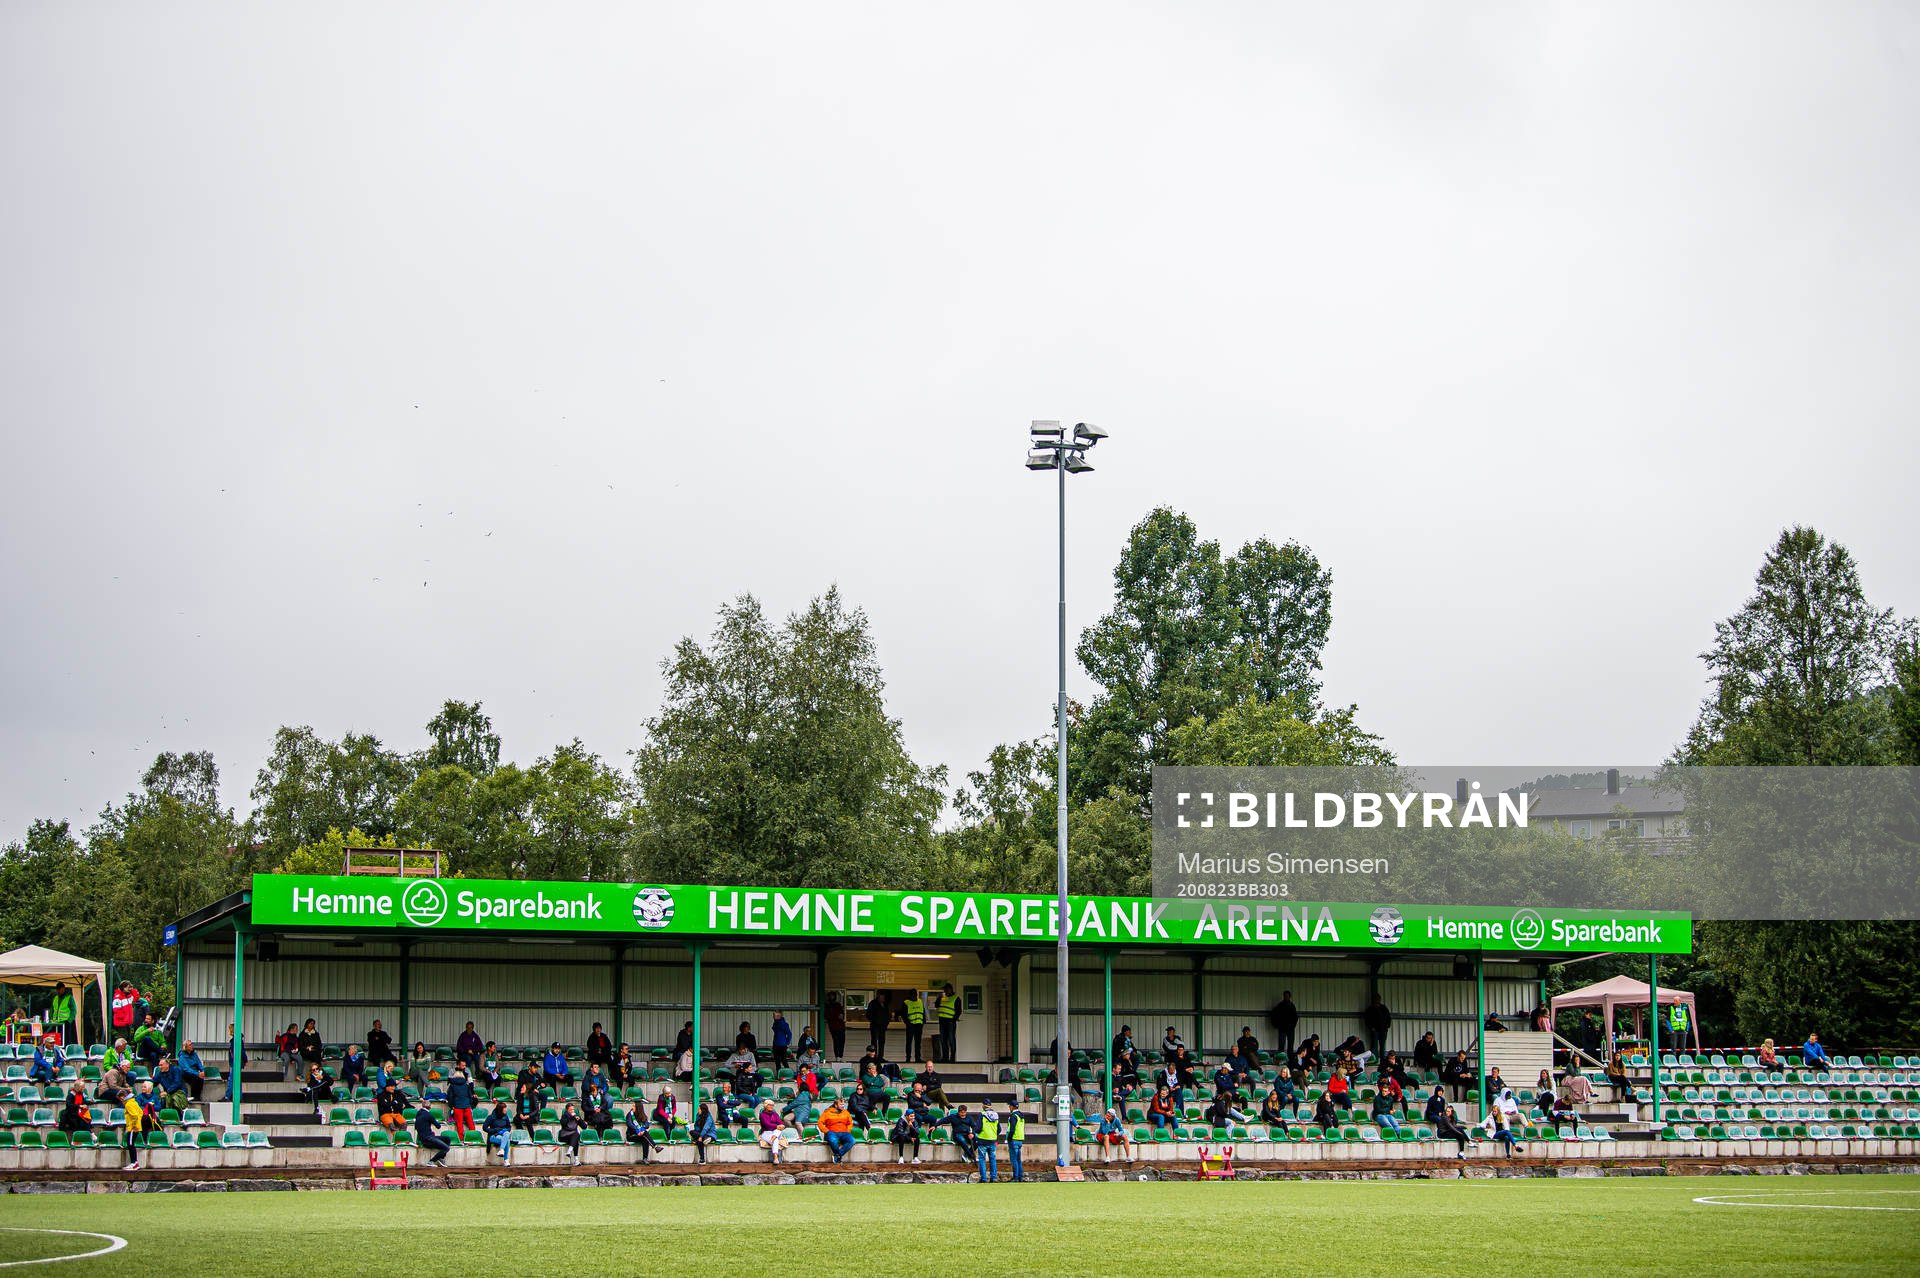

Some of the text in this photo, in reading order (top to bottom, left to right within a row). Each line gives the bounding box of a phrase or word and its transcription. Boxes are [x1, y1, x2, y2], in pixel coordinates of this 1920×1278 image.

[292, 887, 603, 924] Hemne Sparebank
[708, 890, 1340, 943] HEMNE SPAREBANK ARENA
[1426, 915, 1662, 947] Hemne Sparebank
